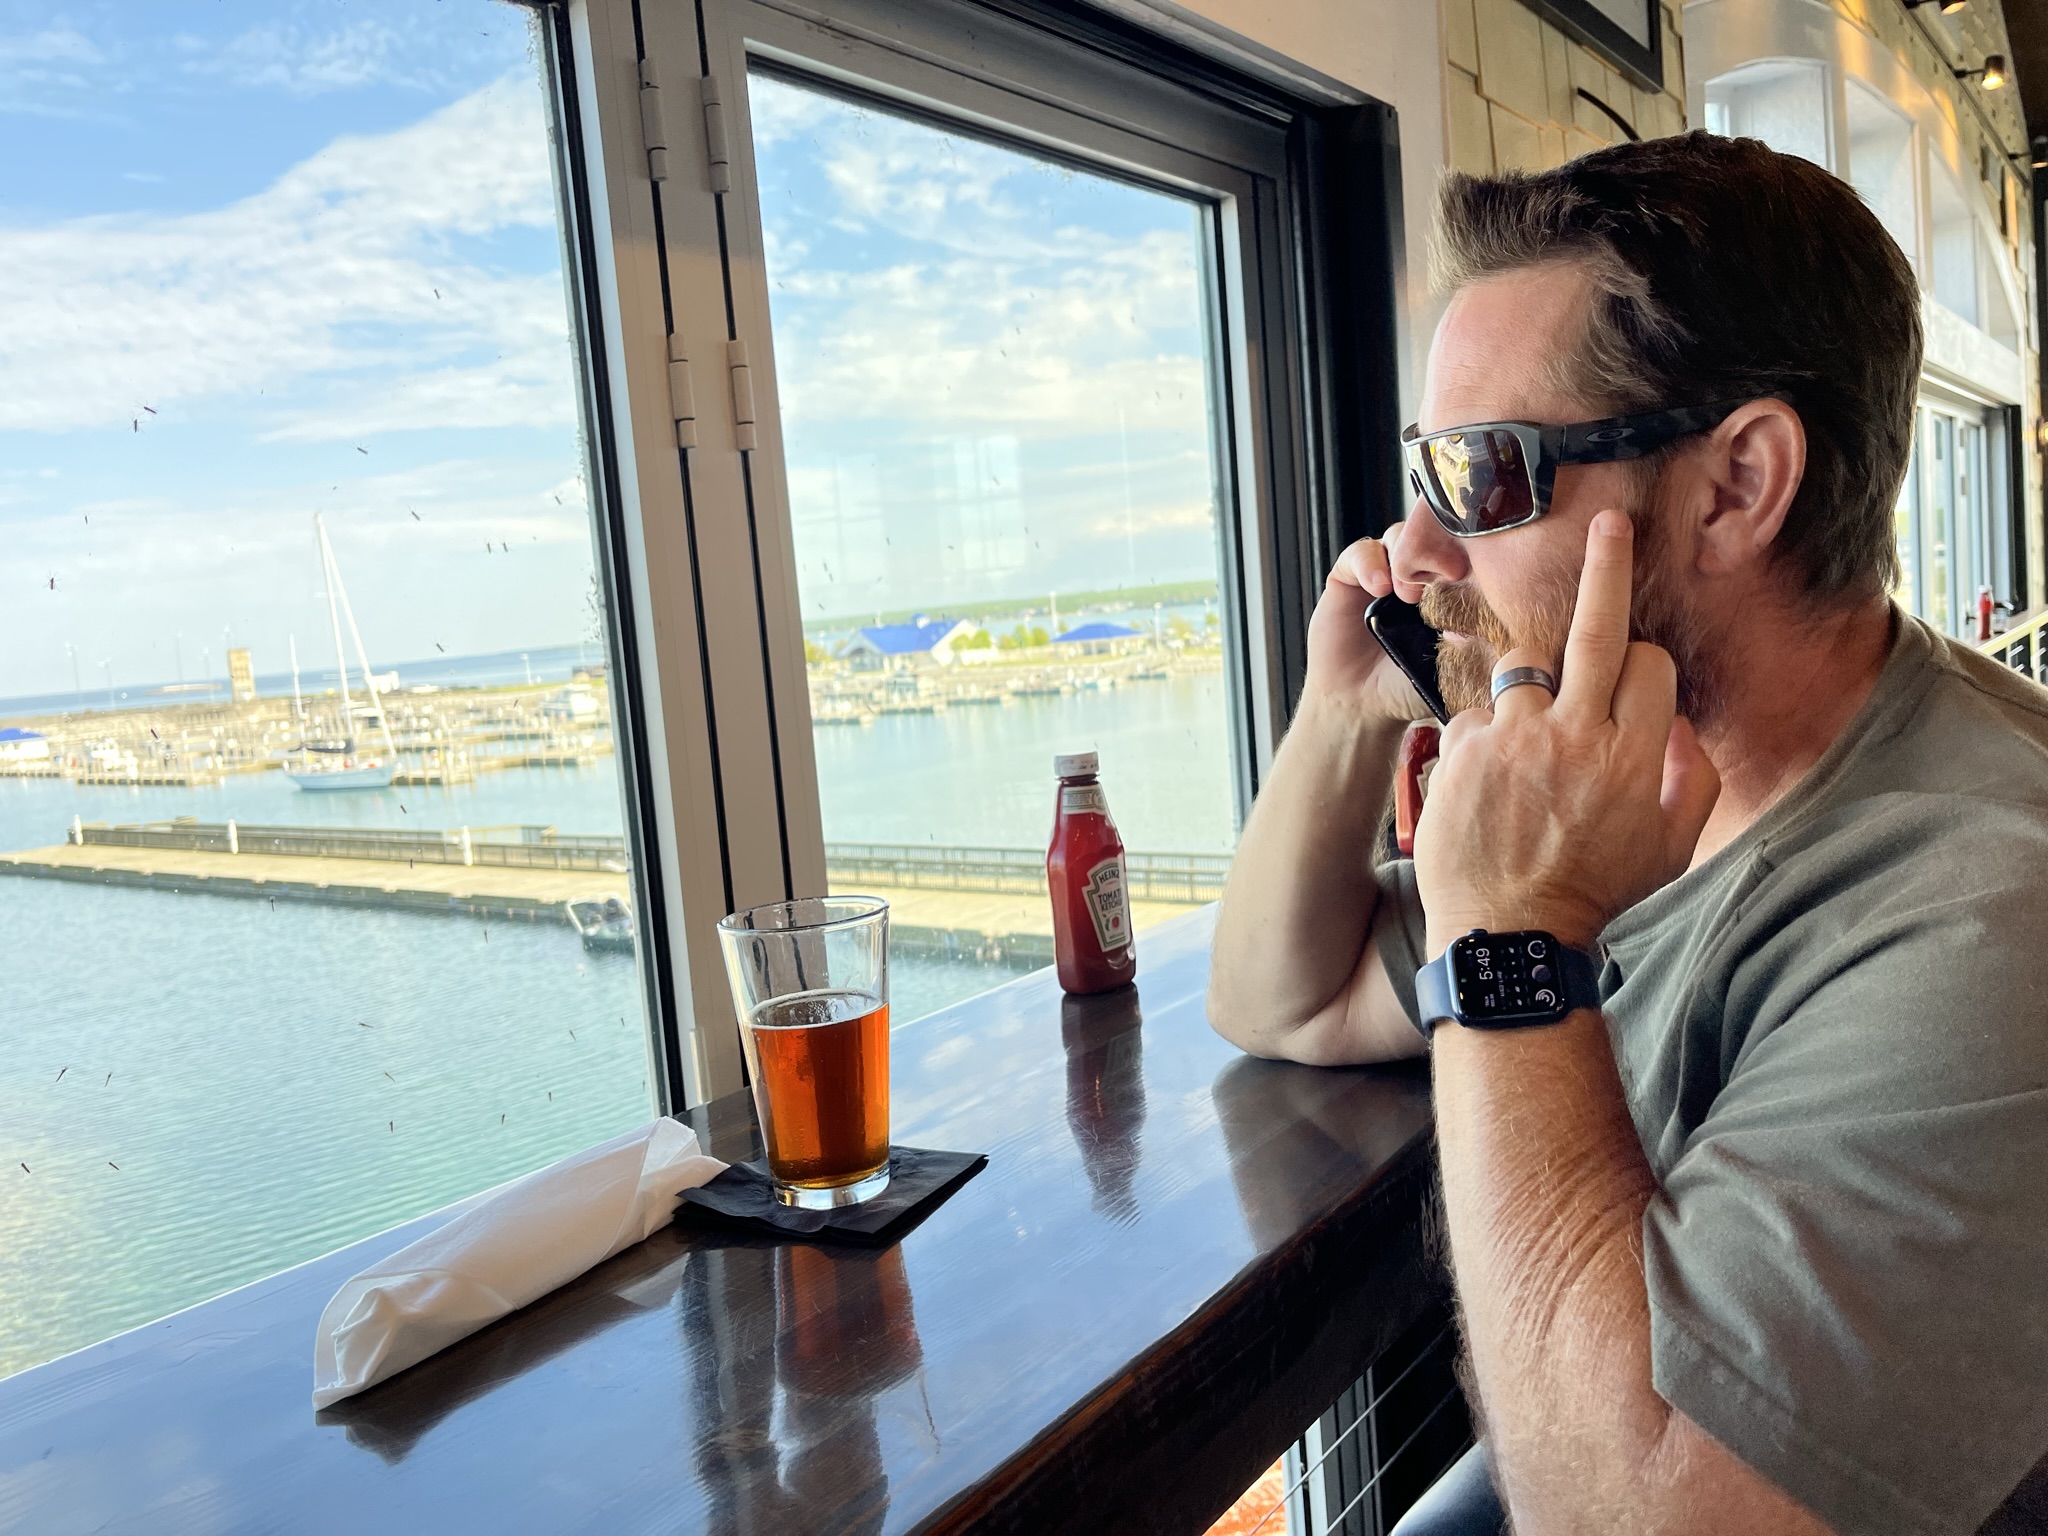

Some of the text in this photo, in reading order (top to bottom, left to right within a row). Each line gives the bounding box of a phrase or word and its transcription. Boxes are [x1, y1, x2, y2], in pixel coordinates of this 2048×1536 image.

[1098, 869, 1119, 884] HEINZ
[1098, 888, 1121, 904] TOMAT
[1101, 897, 1122, 911] KETCHU
[1475, 948, 1493, 980] 5:49
